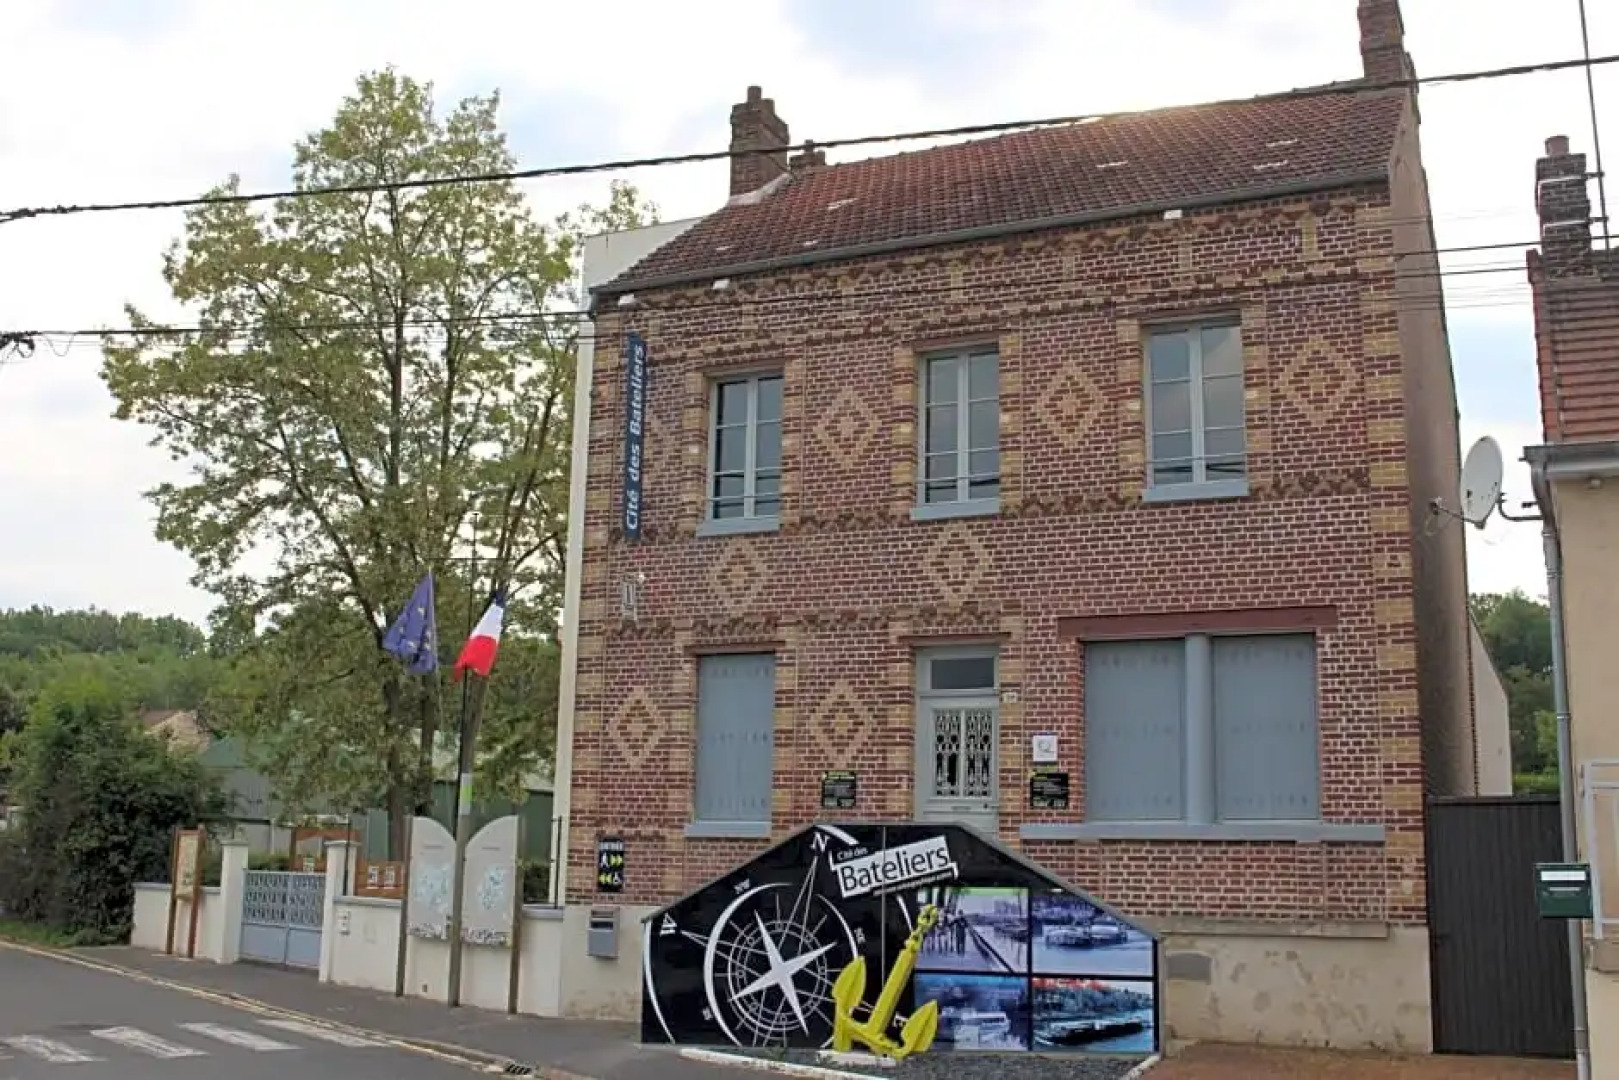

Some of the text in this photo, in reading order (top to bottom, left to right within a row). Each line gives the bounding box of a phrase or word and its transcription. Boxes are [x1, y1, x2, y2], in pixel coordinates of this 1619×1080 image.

[629, 344, 644, 435] Bateliers
[628, 443, 640, 482] des
[811, 831, 830, 853] N
[841, 847, 949, 891] Bateliers
